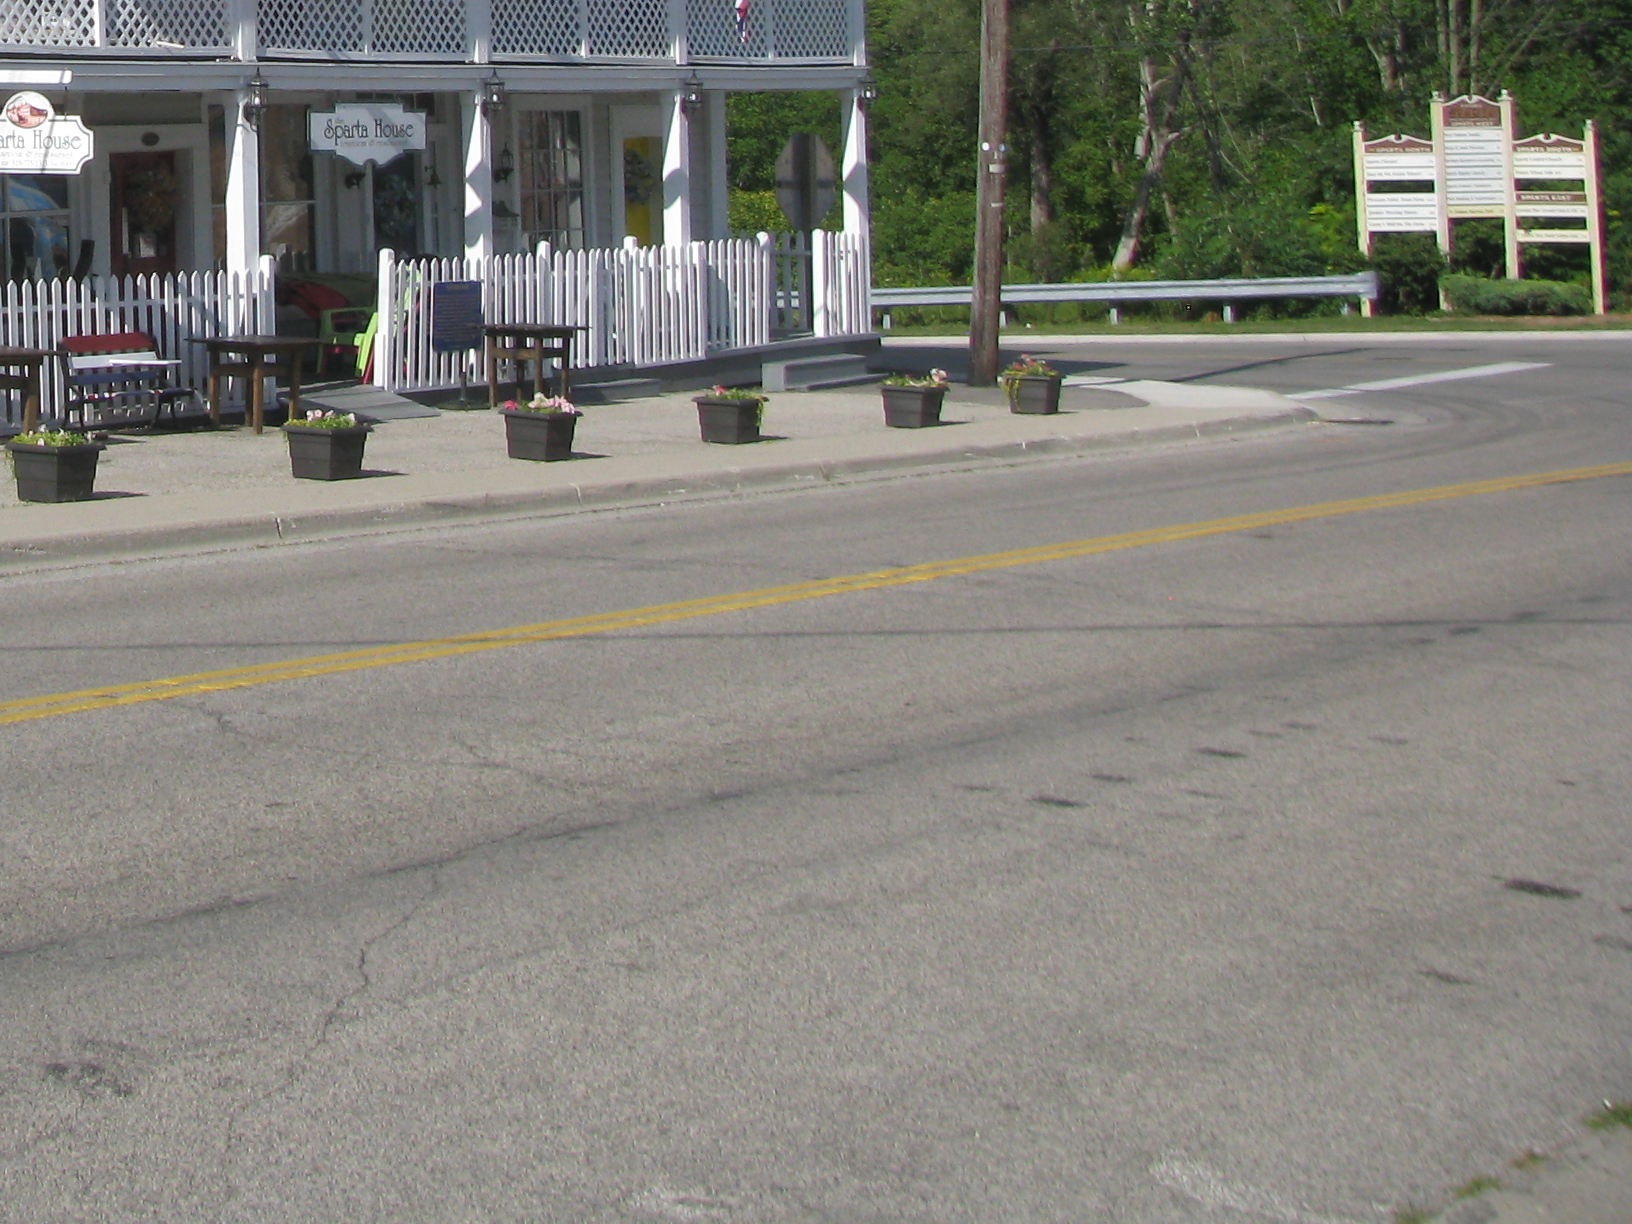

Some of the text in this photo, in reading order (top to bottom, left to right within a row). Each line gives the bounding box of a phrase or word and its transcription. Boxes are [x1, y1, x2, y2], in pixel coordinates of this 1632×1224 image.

[33, 129, 82, 150] House
[323, 118, 414, 146] Sparta House
